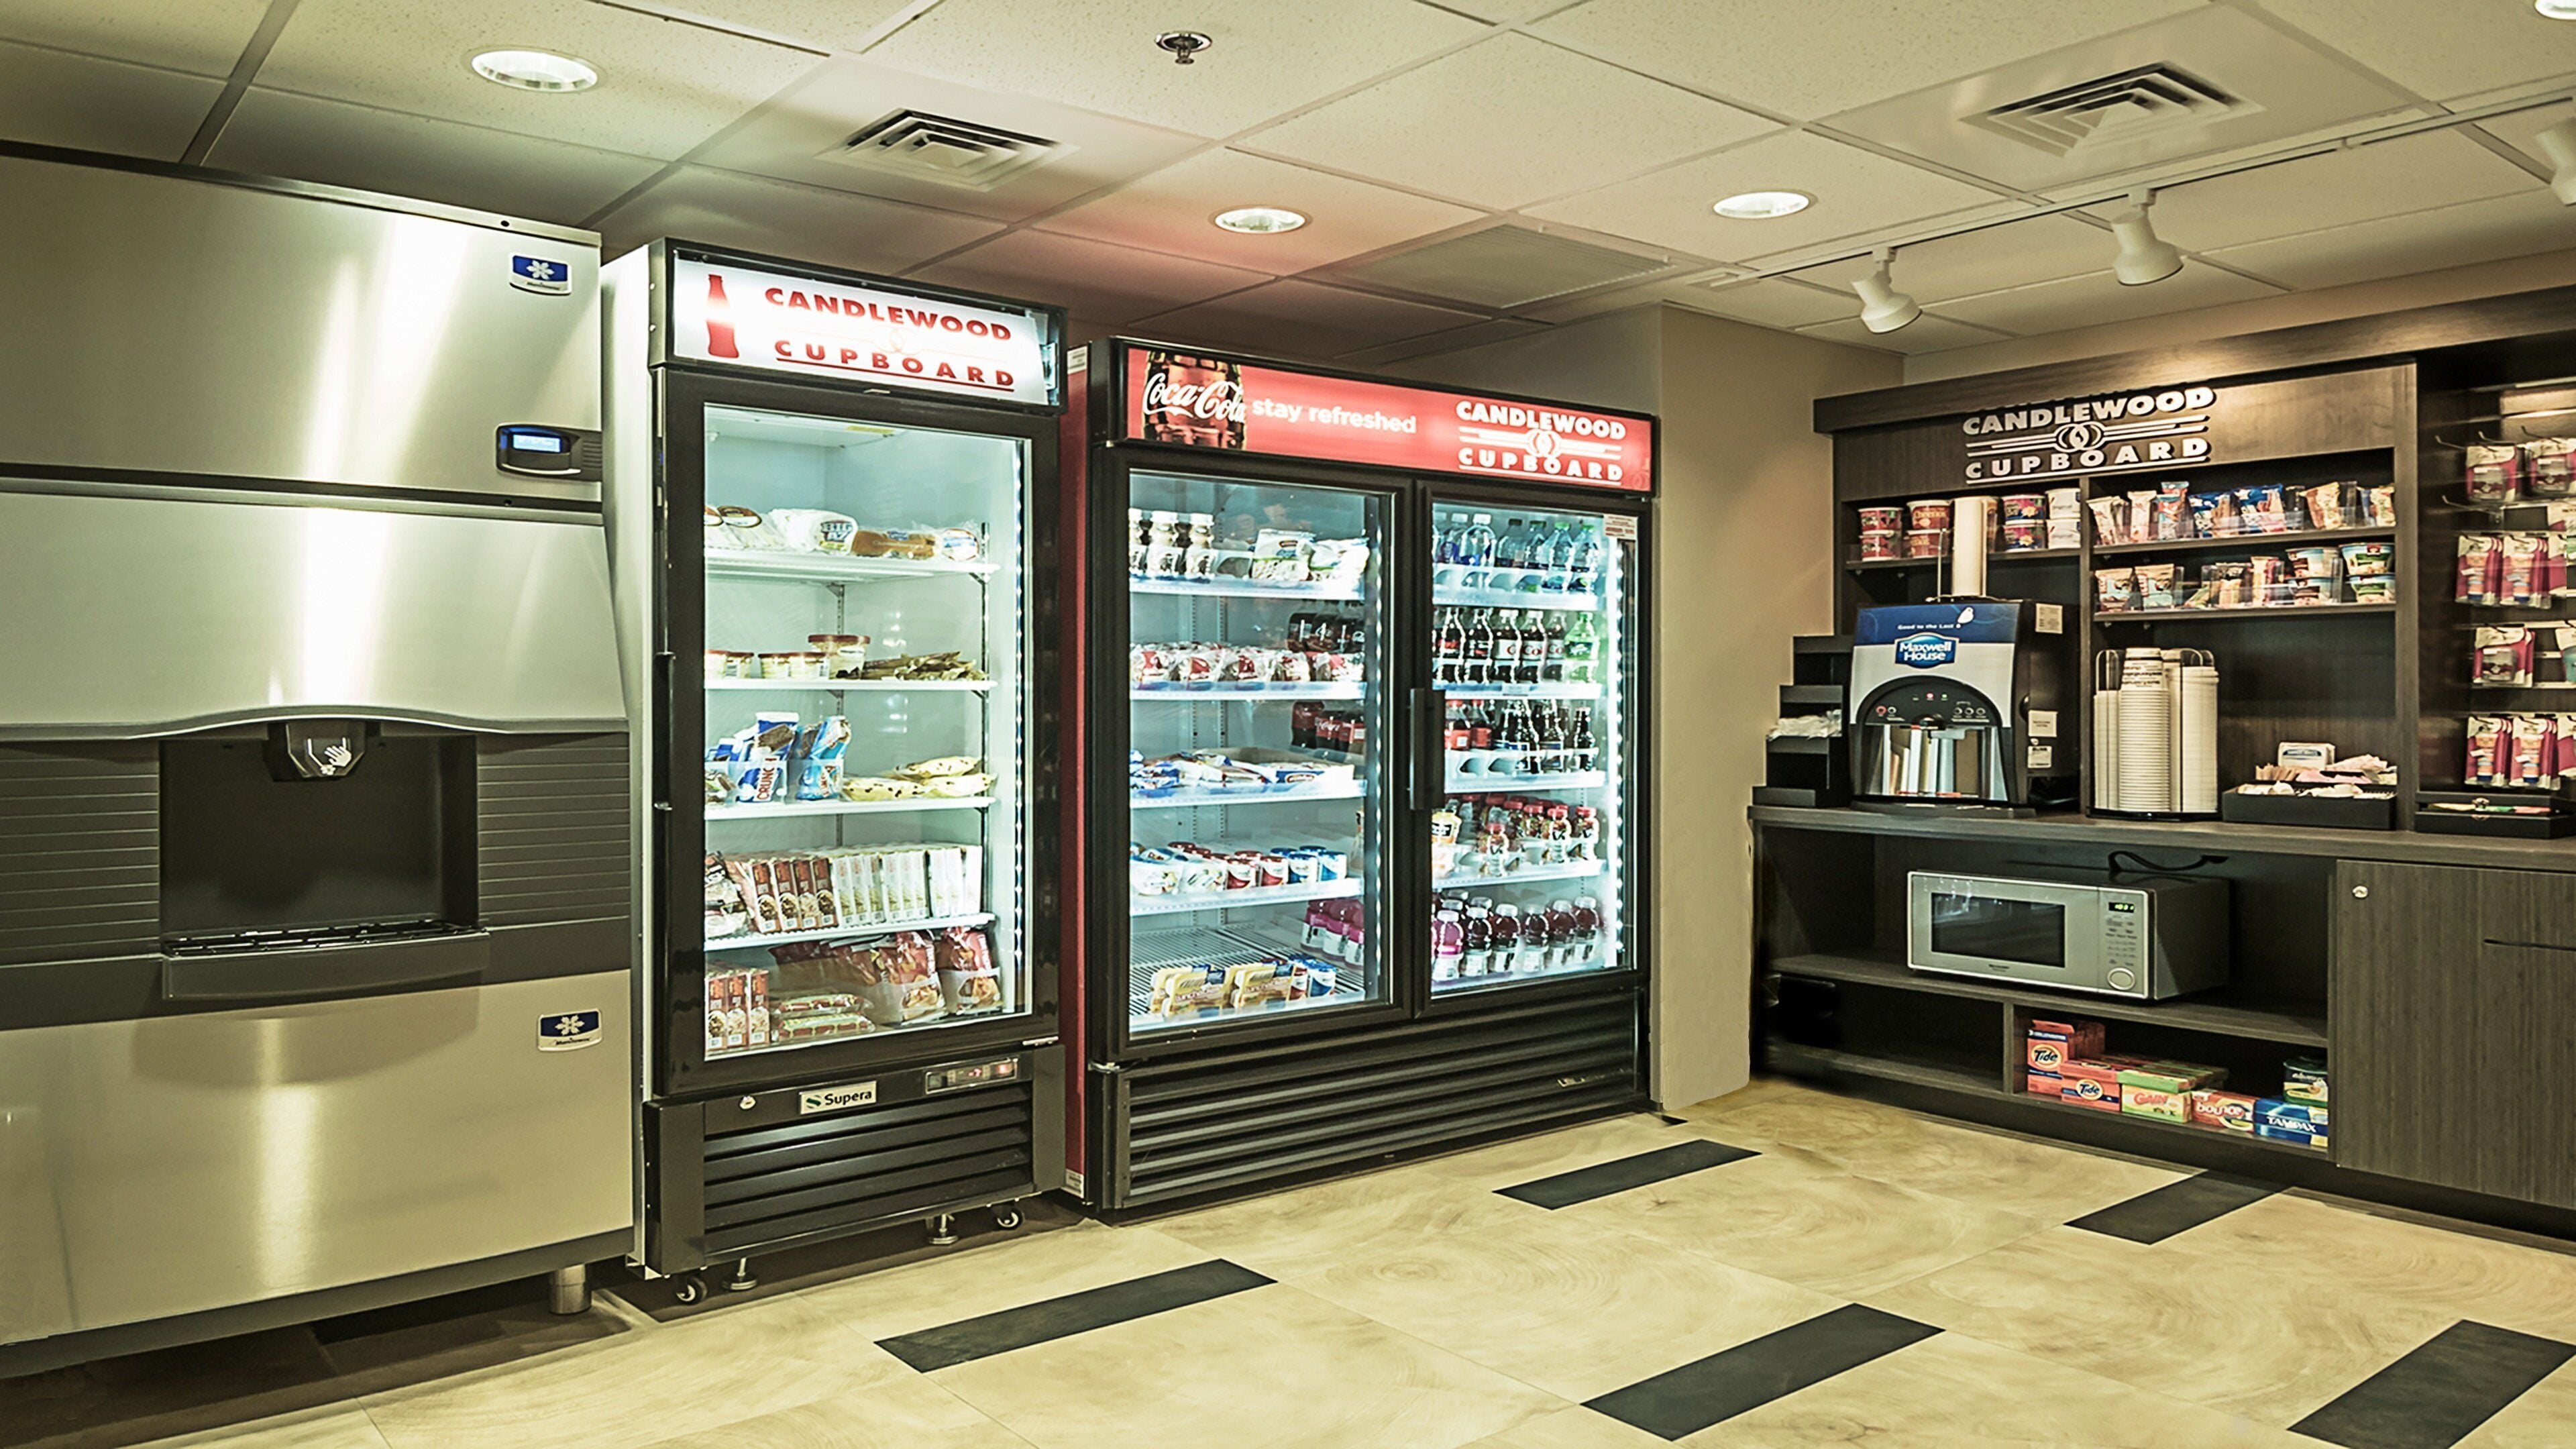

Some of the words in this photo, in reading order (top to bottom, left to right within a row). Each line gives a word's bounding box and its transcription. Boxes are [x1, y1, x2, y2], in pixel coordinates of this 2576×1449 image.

[765, 287, 1012, 341] CANDLEWOOD
[775, 339, 1015, 387] CUPBOARD
[1142, 372, 1246, 423] Coca-Cola
[1962, 387, 2216, 435] CANDLEWOOD
[1252, 398, 1301, 423] stay
[1309, 406, 1417, 434] refreshed
[1456, 400, 1626, 439] CANDLEWOOD
[1458, 447, 1623, 481] CUPBOARD
[1966, 437, 2210, 479] CUPBOARD
[1899, 642, 1952, 652] Maxwell
[1904, 651, 1946, 661] House
[2034, 1050, 2058, 1061] Tide
[824, 1090, 872, 1106] Supera
[2080, 1083, 2100, 1094] Tide
[2266, 1116, 2317, 1132] TAMPAX
